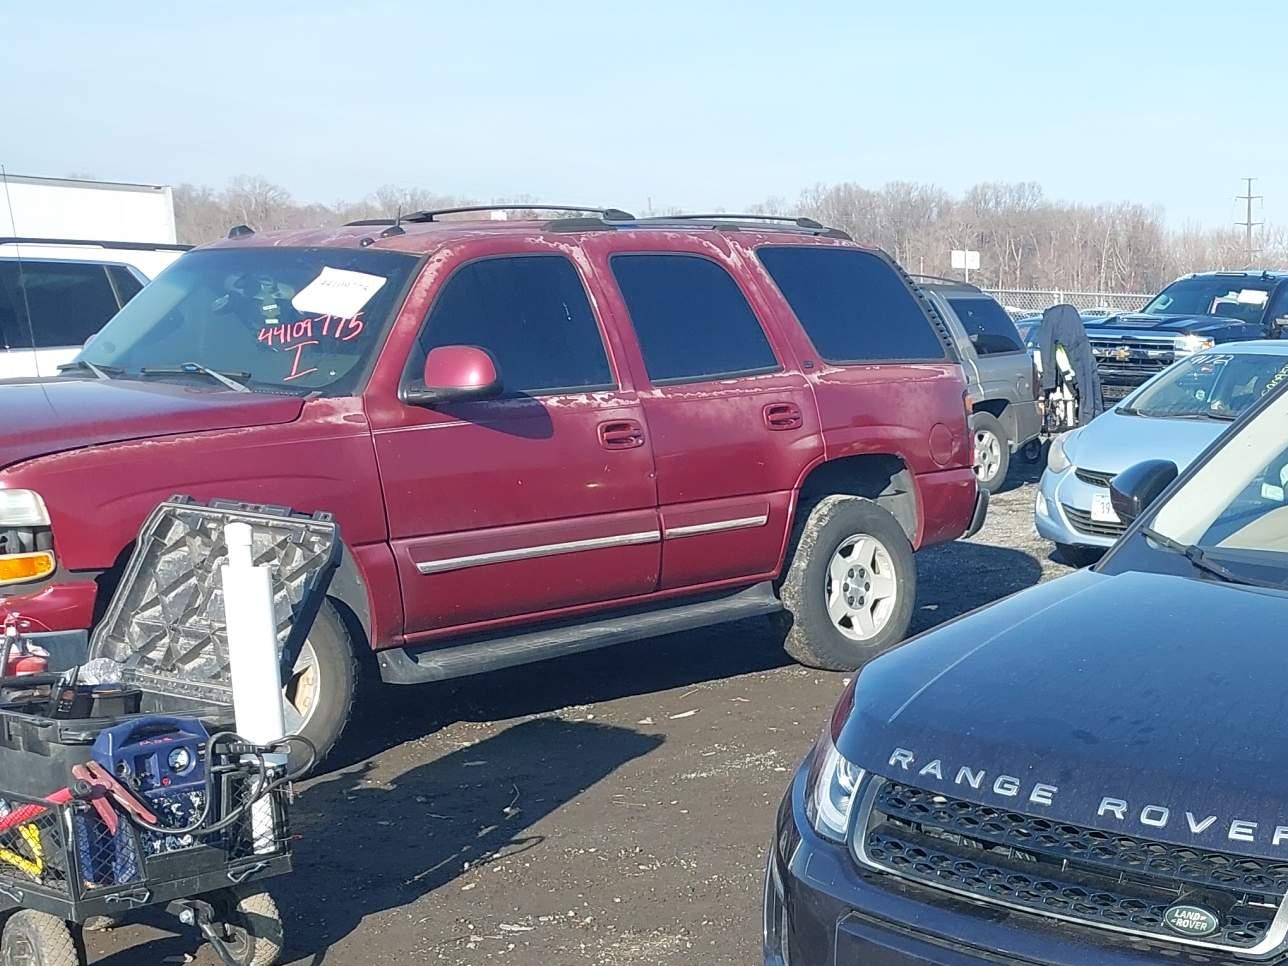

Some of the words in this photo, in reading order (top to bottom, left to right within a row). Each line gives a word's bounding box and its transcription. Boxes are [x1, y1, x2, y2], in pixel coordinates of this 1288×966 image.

[888, 747, 1059, 806] RANGE
[1174, 908, 1201, 921] LAND
[1175, 918, 1208, 931] ROVER
